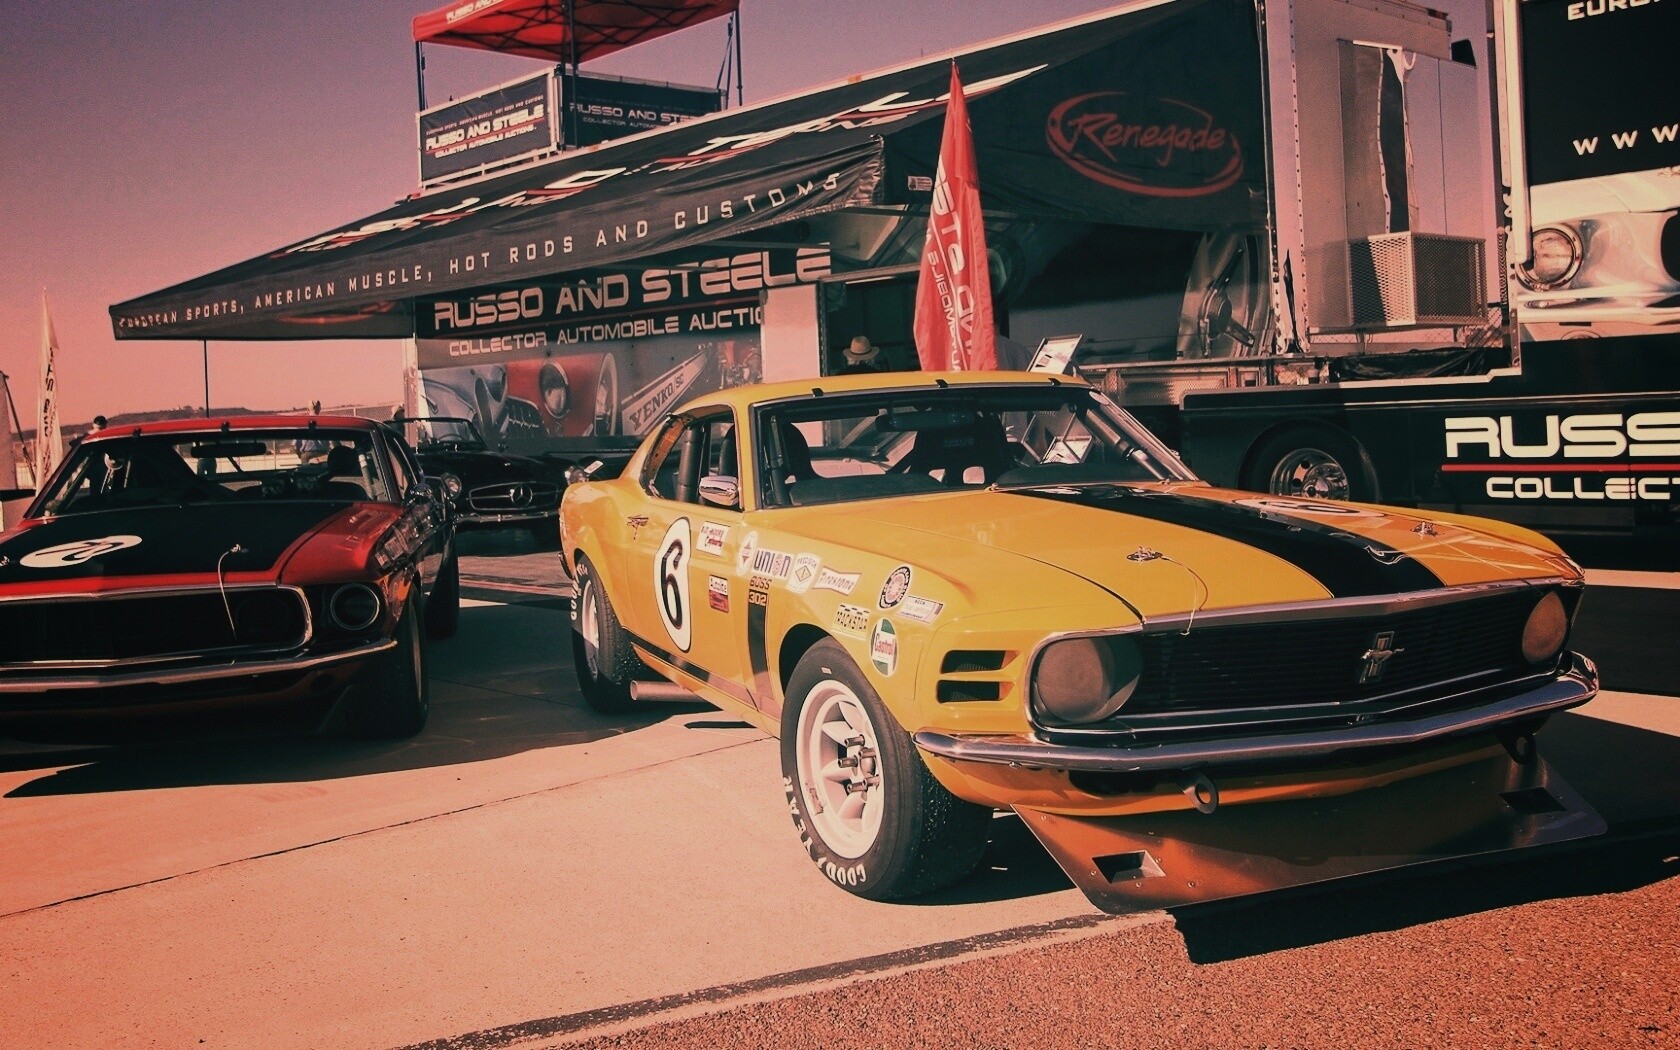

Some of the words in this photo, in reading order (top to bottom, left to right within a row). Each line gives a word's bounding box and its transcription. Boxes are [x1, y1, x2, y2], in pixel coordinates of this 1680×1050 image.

[426, 128, 465, 151] RUSSO
[467, 120, 491, 139] AND
[492, 104, 544, 131] STEELE
[569, 102, 623, 117] RUSSO
[628, 109, 657, 121] AND
[582, 117, 626, 126] COLLECTOR
[468, 133, 504, 149] AUTOMOBILE
[1066, 112, 1226, 167] Renegade
[255, 282, 335, 309] AMERICAN
[450, 252, 491, 274] HOT
[509, 236, 574, 263] RODS
[596, 220, 648, 247] AND
[675, 172, 840, 229] CUSTOMS
[434, 288, 543, 330] RUSSO
[556, 273, 630, 315] AND
[642, 243, 831, 302] STEELE
[449, 332, 547, 357] COLLECTOR
[557, 316, 680, 346] AUTOMOBILE
[629, 383, 675, 431] YENKO
[660, 539, 683, 630] 6
[749, 575, 772, 590] BOSS
[749, 591, 767, 606] 302
